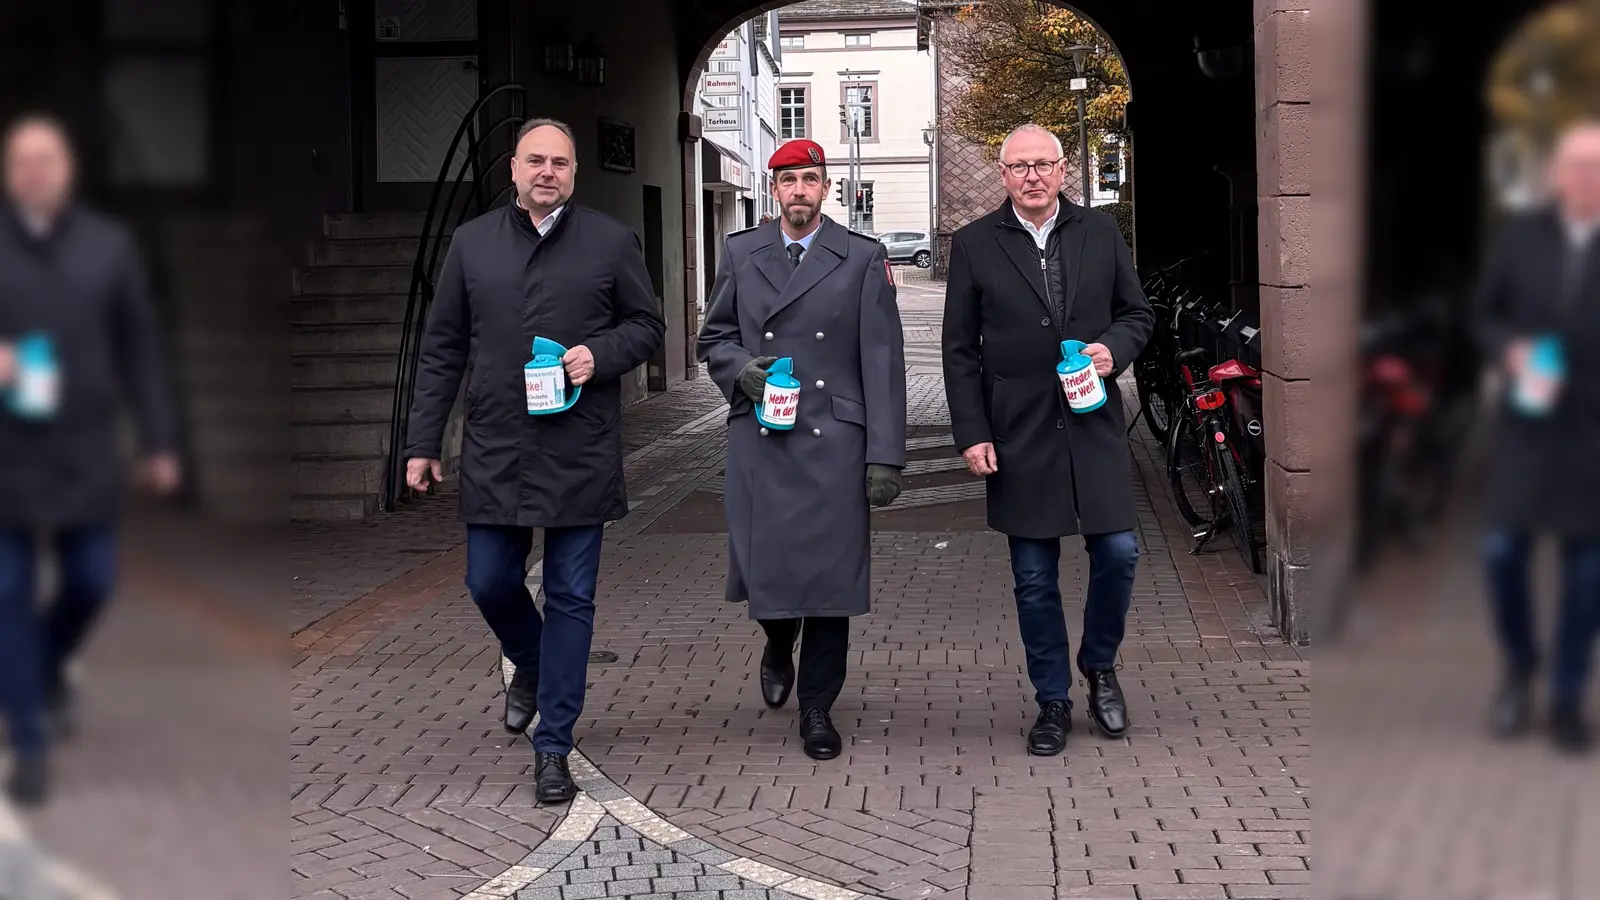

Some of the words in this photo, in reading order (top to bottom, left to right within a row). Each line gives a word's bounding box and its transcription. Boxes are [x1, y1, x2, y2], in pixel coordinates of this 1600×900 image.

[1065, 369, 1092, 389] Frieden
[1078, 381, 1096, 397] Welt
[768, 393, 789, 405] Mehr
[773, 406, 781, 416] in
[783, 406, 795, 416] der
